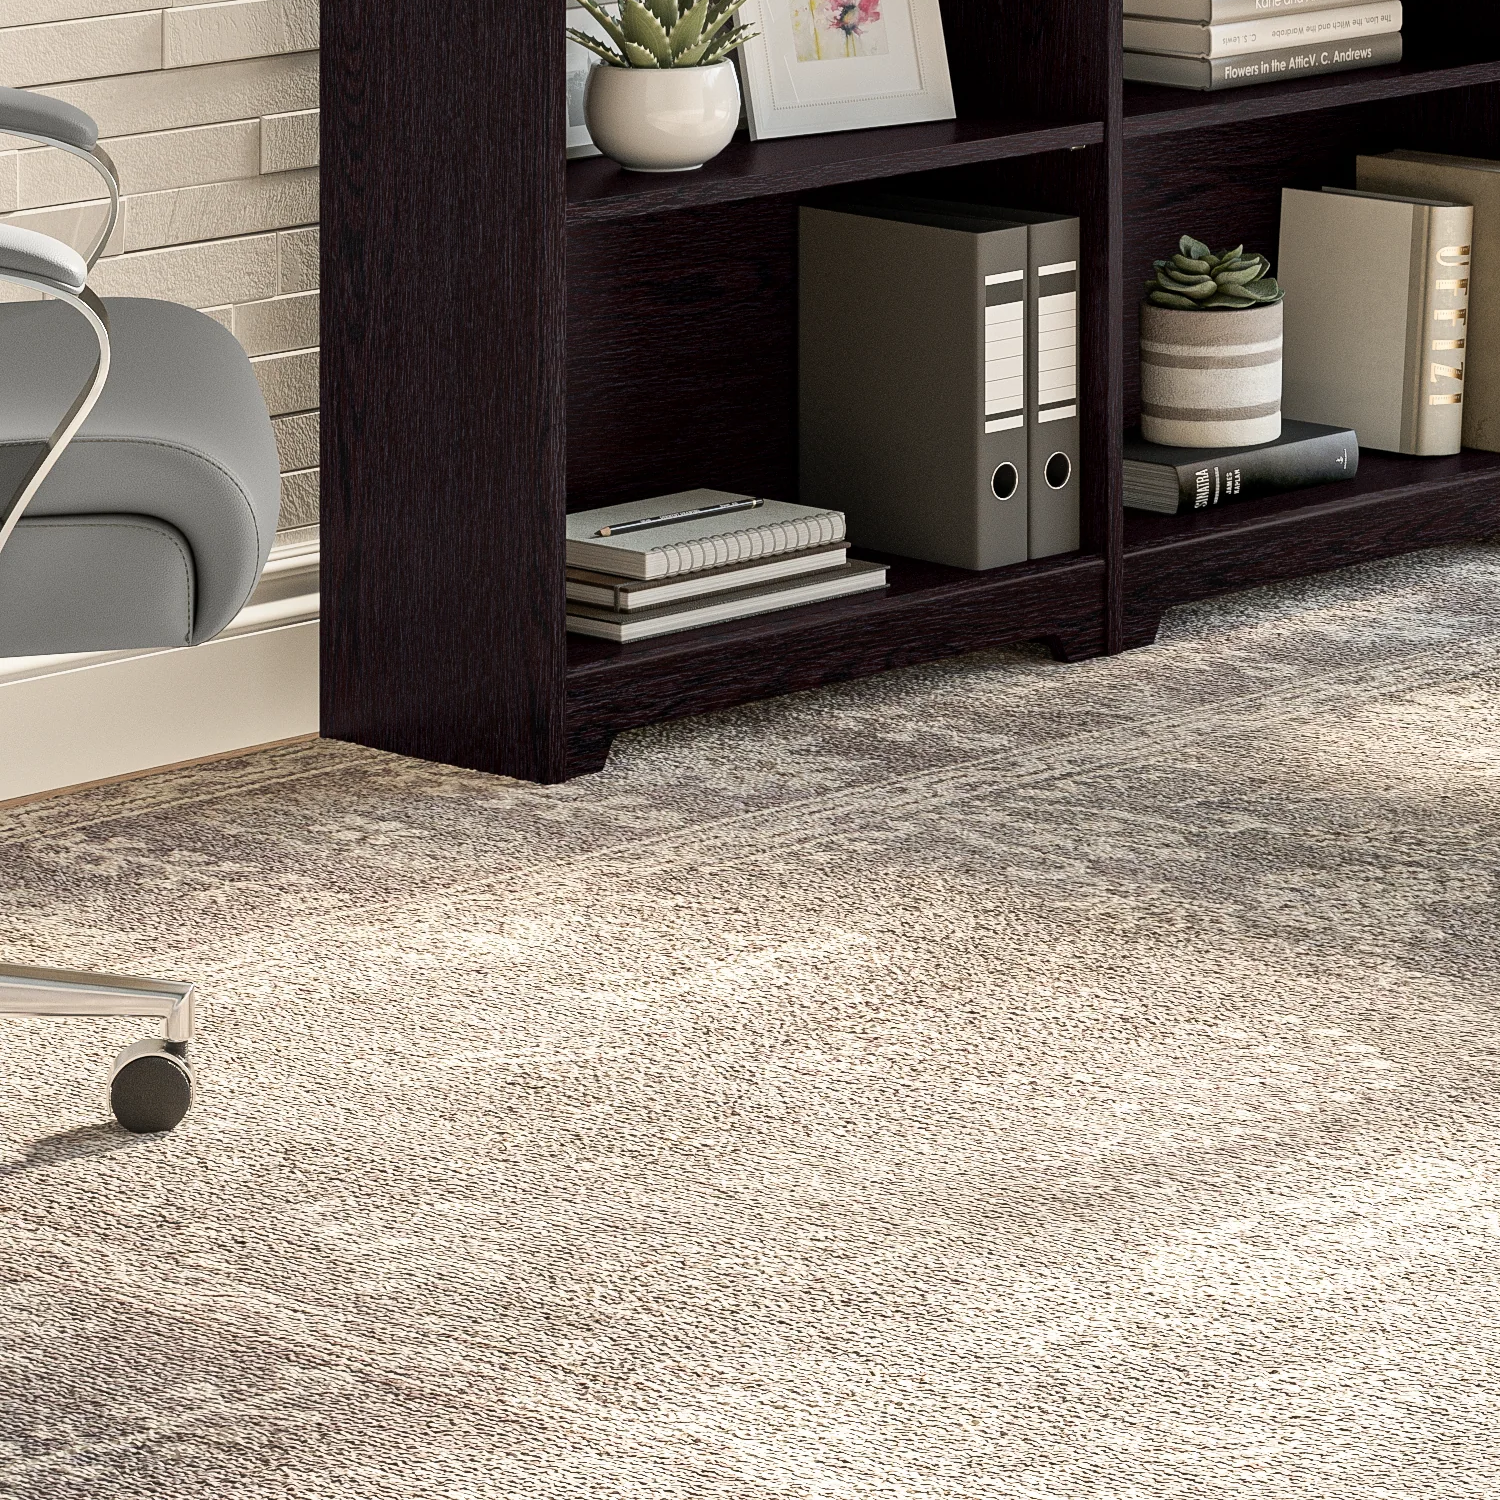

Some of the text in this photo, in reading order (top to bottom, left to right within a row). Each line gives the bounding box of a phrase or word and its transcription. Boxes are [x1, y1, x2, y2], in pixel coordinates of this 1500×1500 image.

[1352, 18, 1363, 27] the
[1380, 14, 1392, 23] The
[1305, 25, 1317, 34] the
[1317, 22, 1331, 33] and
[1332, 20, 1351, 31] Witch
[1271, 26, 1305, 38] Wardrobe
[1222, 35, 1240, 46] Lewis
[1224, 64, 1259, 80] Flowers
[1260, 61, 1270, 74] in
[1271, 58, 1287, 73] the
[1320, 51, 1331, 65] C.
[1332, 47, 1373, 63] Andrews
[1429, 245, 1470, 406] UFFIZI
[1225, 472, 1233, 495] JAMES
[1233, 468, 1241, 495] KAPLAN
[1194, 468, 1210, 509] SINATRA
